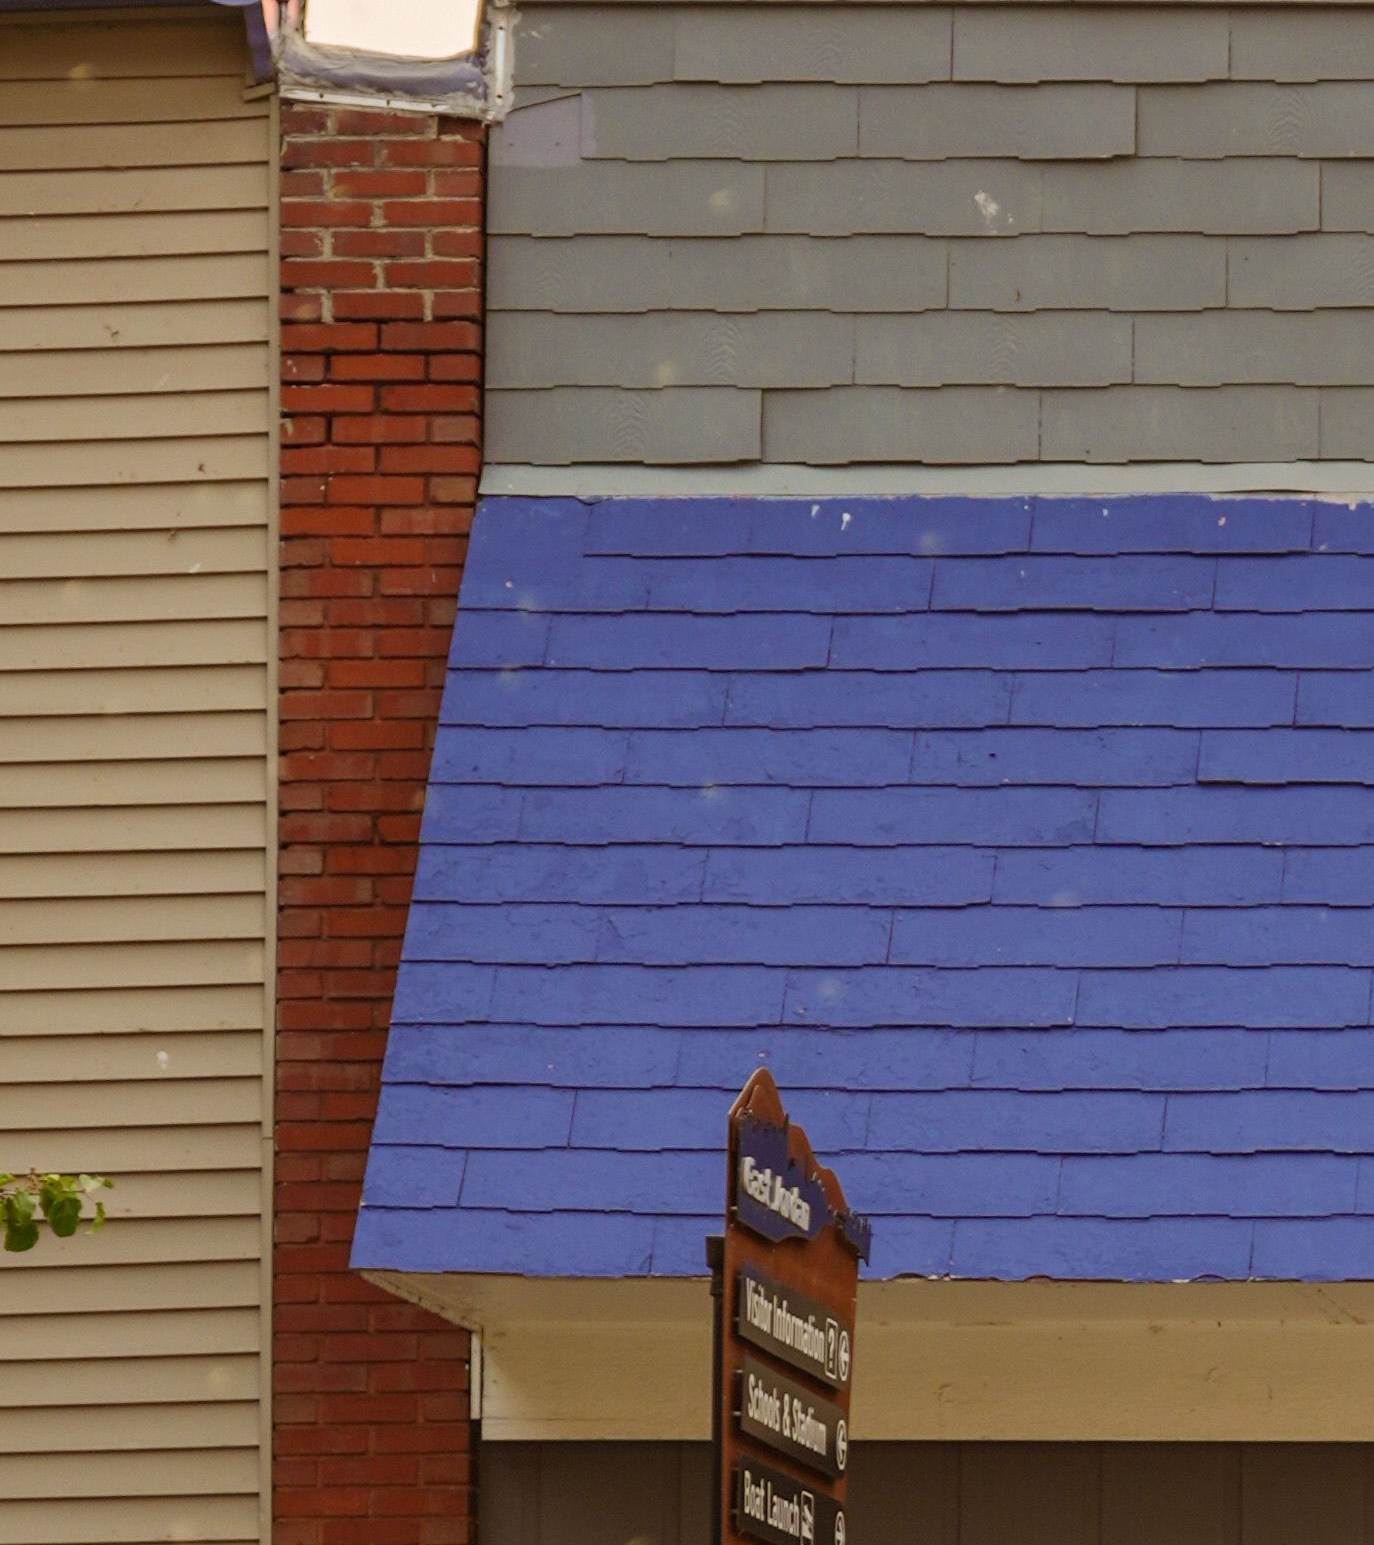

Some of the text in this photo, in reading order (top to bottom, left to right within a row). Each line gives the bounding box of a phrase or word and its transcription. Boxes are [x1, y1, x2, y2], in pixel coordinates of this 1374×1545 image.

[741, 1156, 811, 1231] East Jordan
[746, 1277, 772, 1334] Visitor
[772, 1295, 825, 1363] Information
[748, 1373, 826, 1456] Schools & Stadium
[744, 1469, 800, 1537] Boat Launch
